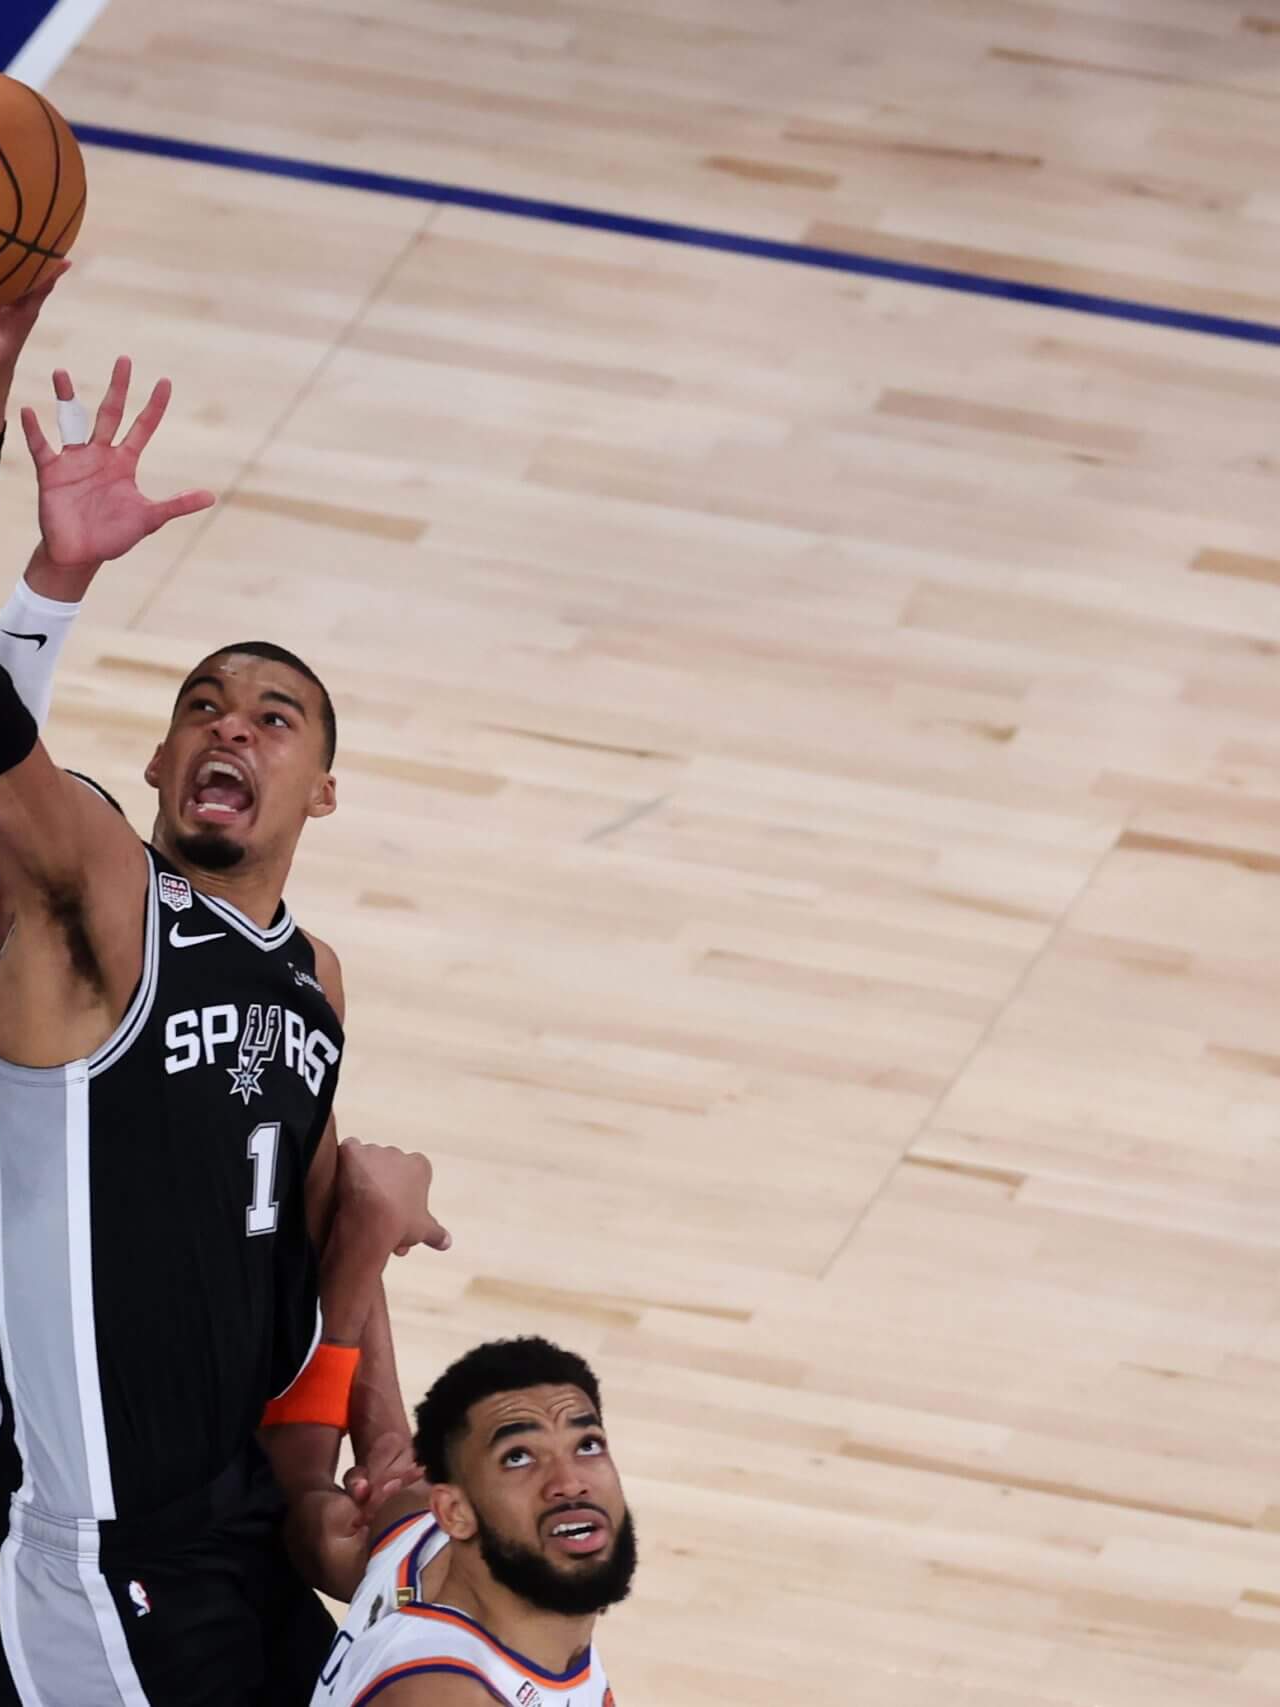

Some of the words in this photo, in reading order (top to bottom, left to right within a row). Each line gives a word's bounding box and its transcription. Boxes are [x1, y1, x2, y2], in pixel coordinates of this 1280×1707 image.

[163, 877, 187, 890] USA
[165, 1004, 338, 1096] SPURS
[247, 1121, 281, 1236] 1
